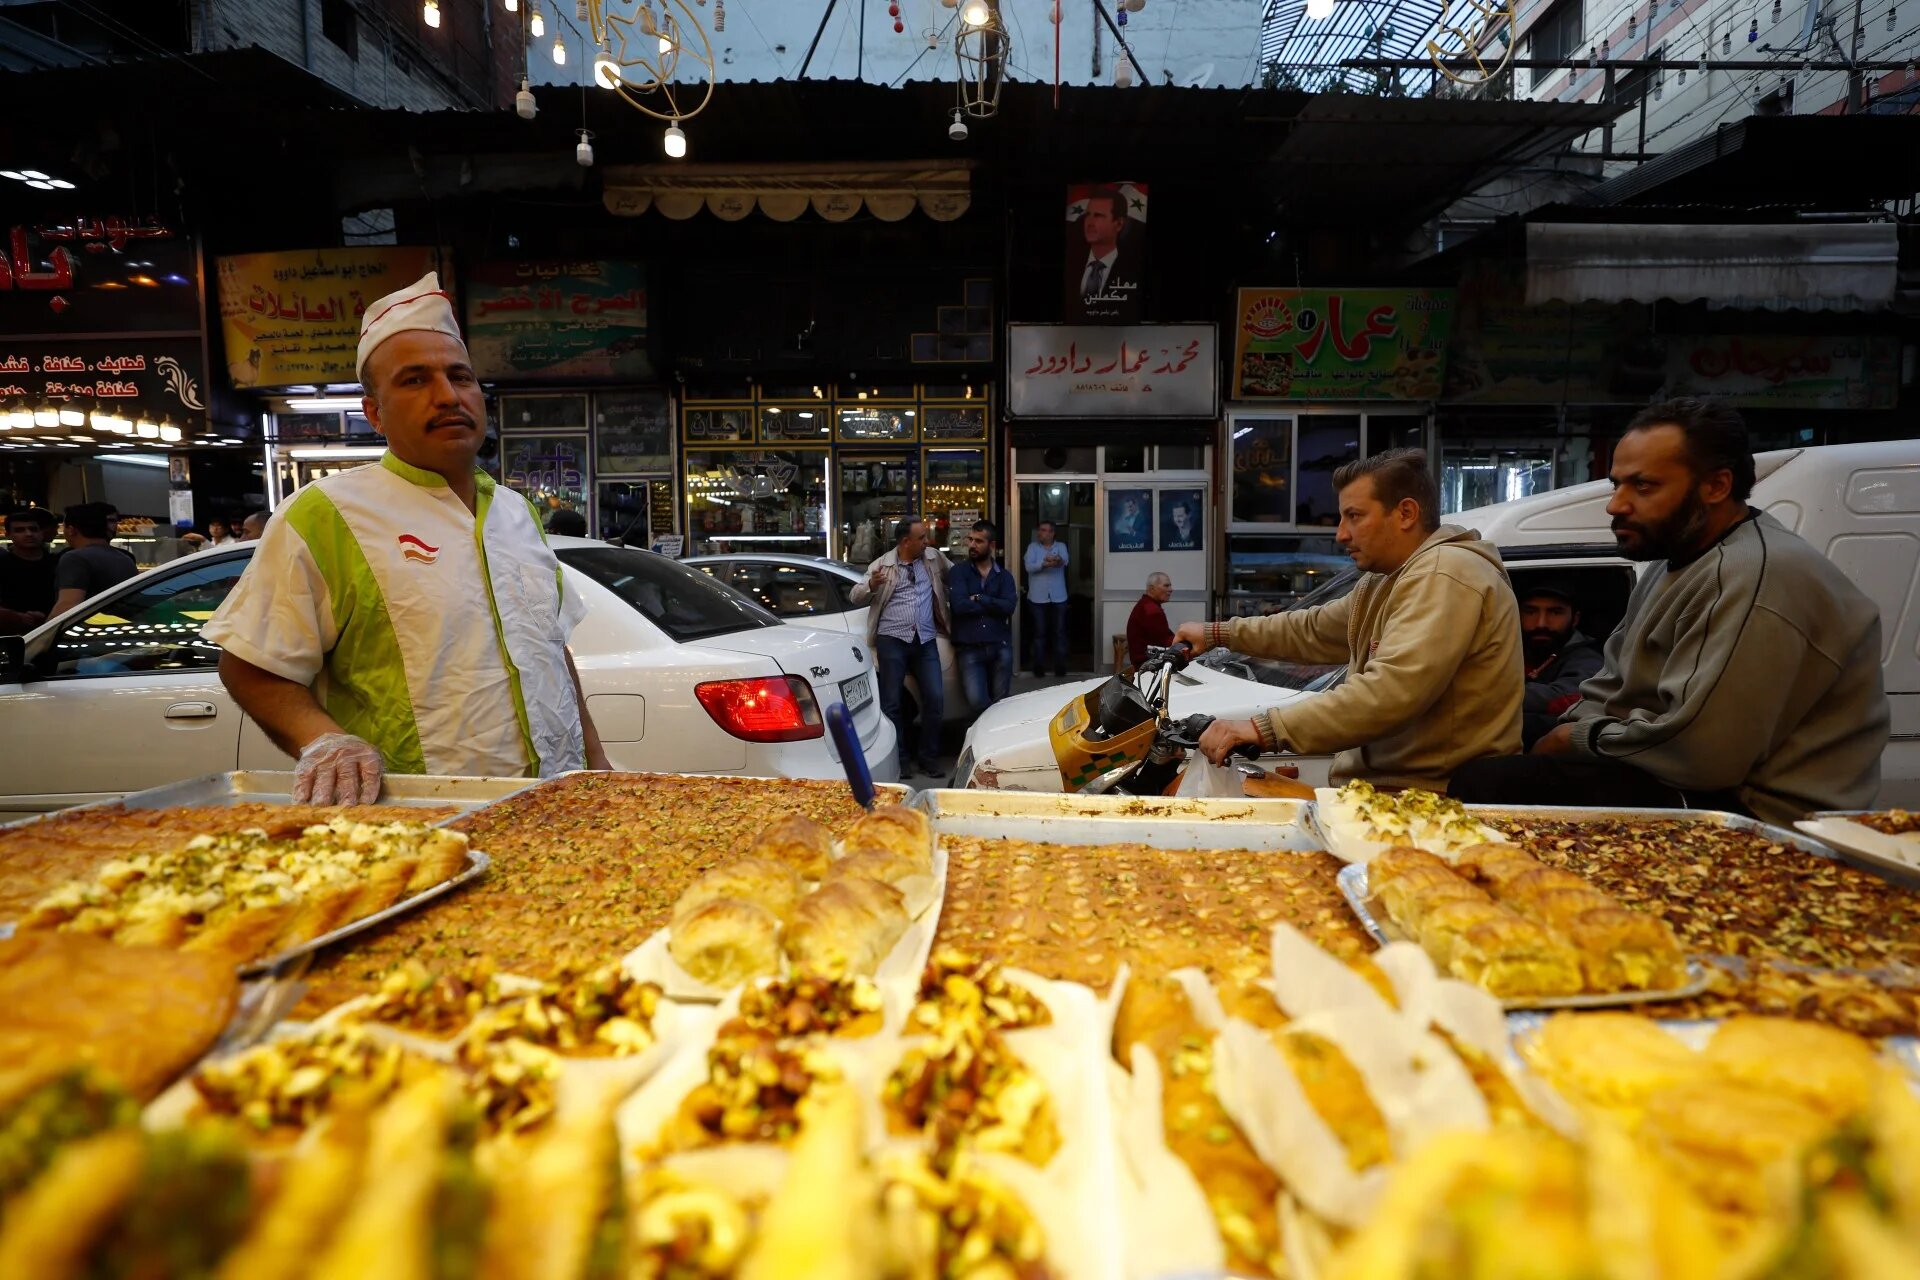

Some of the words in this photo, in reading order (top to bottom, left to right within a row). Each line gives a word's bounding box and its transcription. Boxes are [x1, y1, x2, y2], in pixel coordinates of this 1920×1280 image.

[1108, 276, 1137, 289] معك
[570, 288, 646, 315] المرج
[1084, 290, 1128, 305] مكملين
[1294, 296, 1398, 365] عمار
[43, 355, 86, 372] كنافة
[97, 354, 146, 375] قطايف
[1024, 341, 1091, 375] داوود
[1094, 340, 1151, 375] عمار
[96, 381, 139, 397] كنافة
[810, 666, 831, 678] Rio
